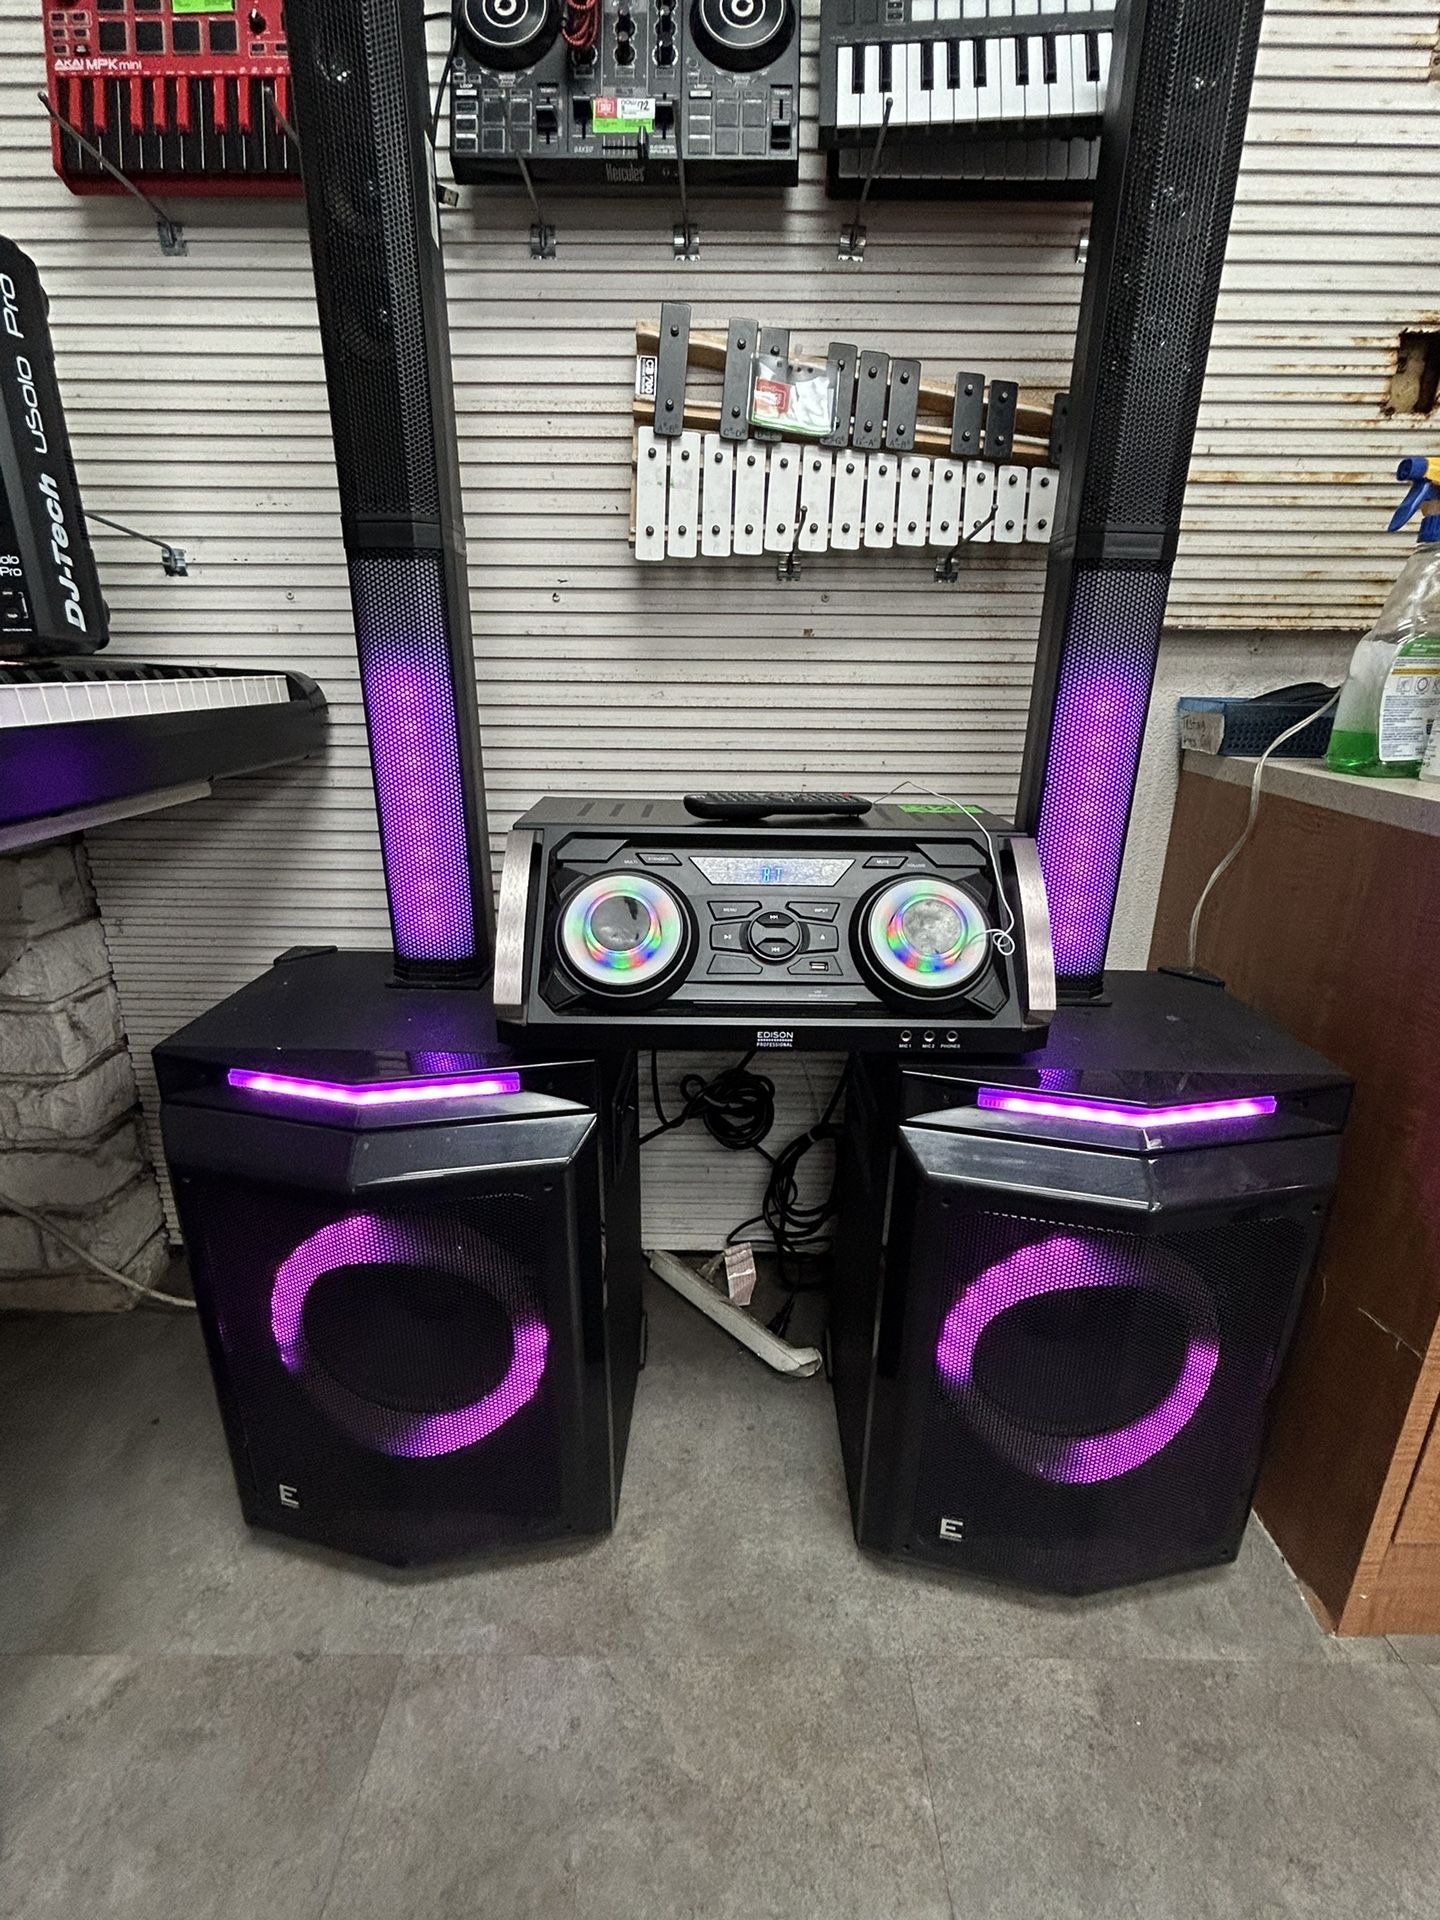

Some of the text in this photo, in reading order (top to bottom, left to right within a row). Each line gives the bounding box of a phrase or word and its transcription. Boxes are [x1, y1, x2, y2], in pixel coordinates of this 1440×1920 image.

[54, 58, 142, 70] AKAI MPK mini
[605, 163, 646, 182] Hercules
[0, 273, 25, 339] Pro
[38, 473, 87, 632] DJ-Tech
[0, 566, 22, 576] Pro
[757, 1031, 794, 1039] EDISON
[279, 1484, 299, 1505] E
[940, 1518, 964, 1539] E
